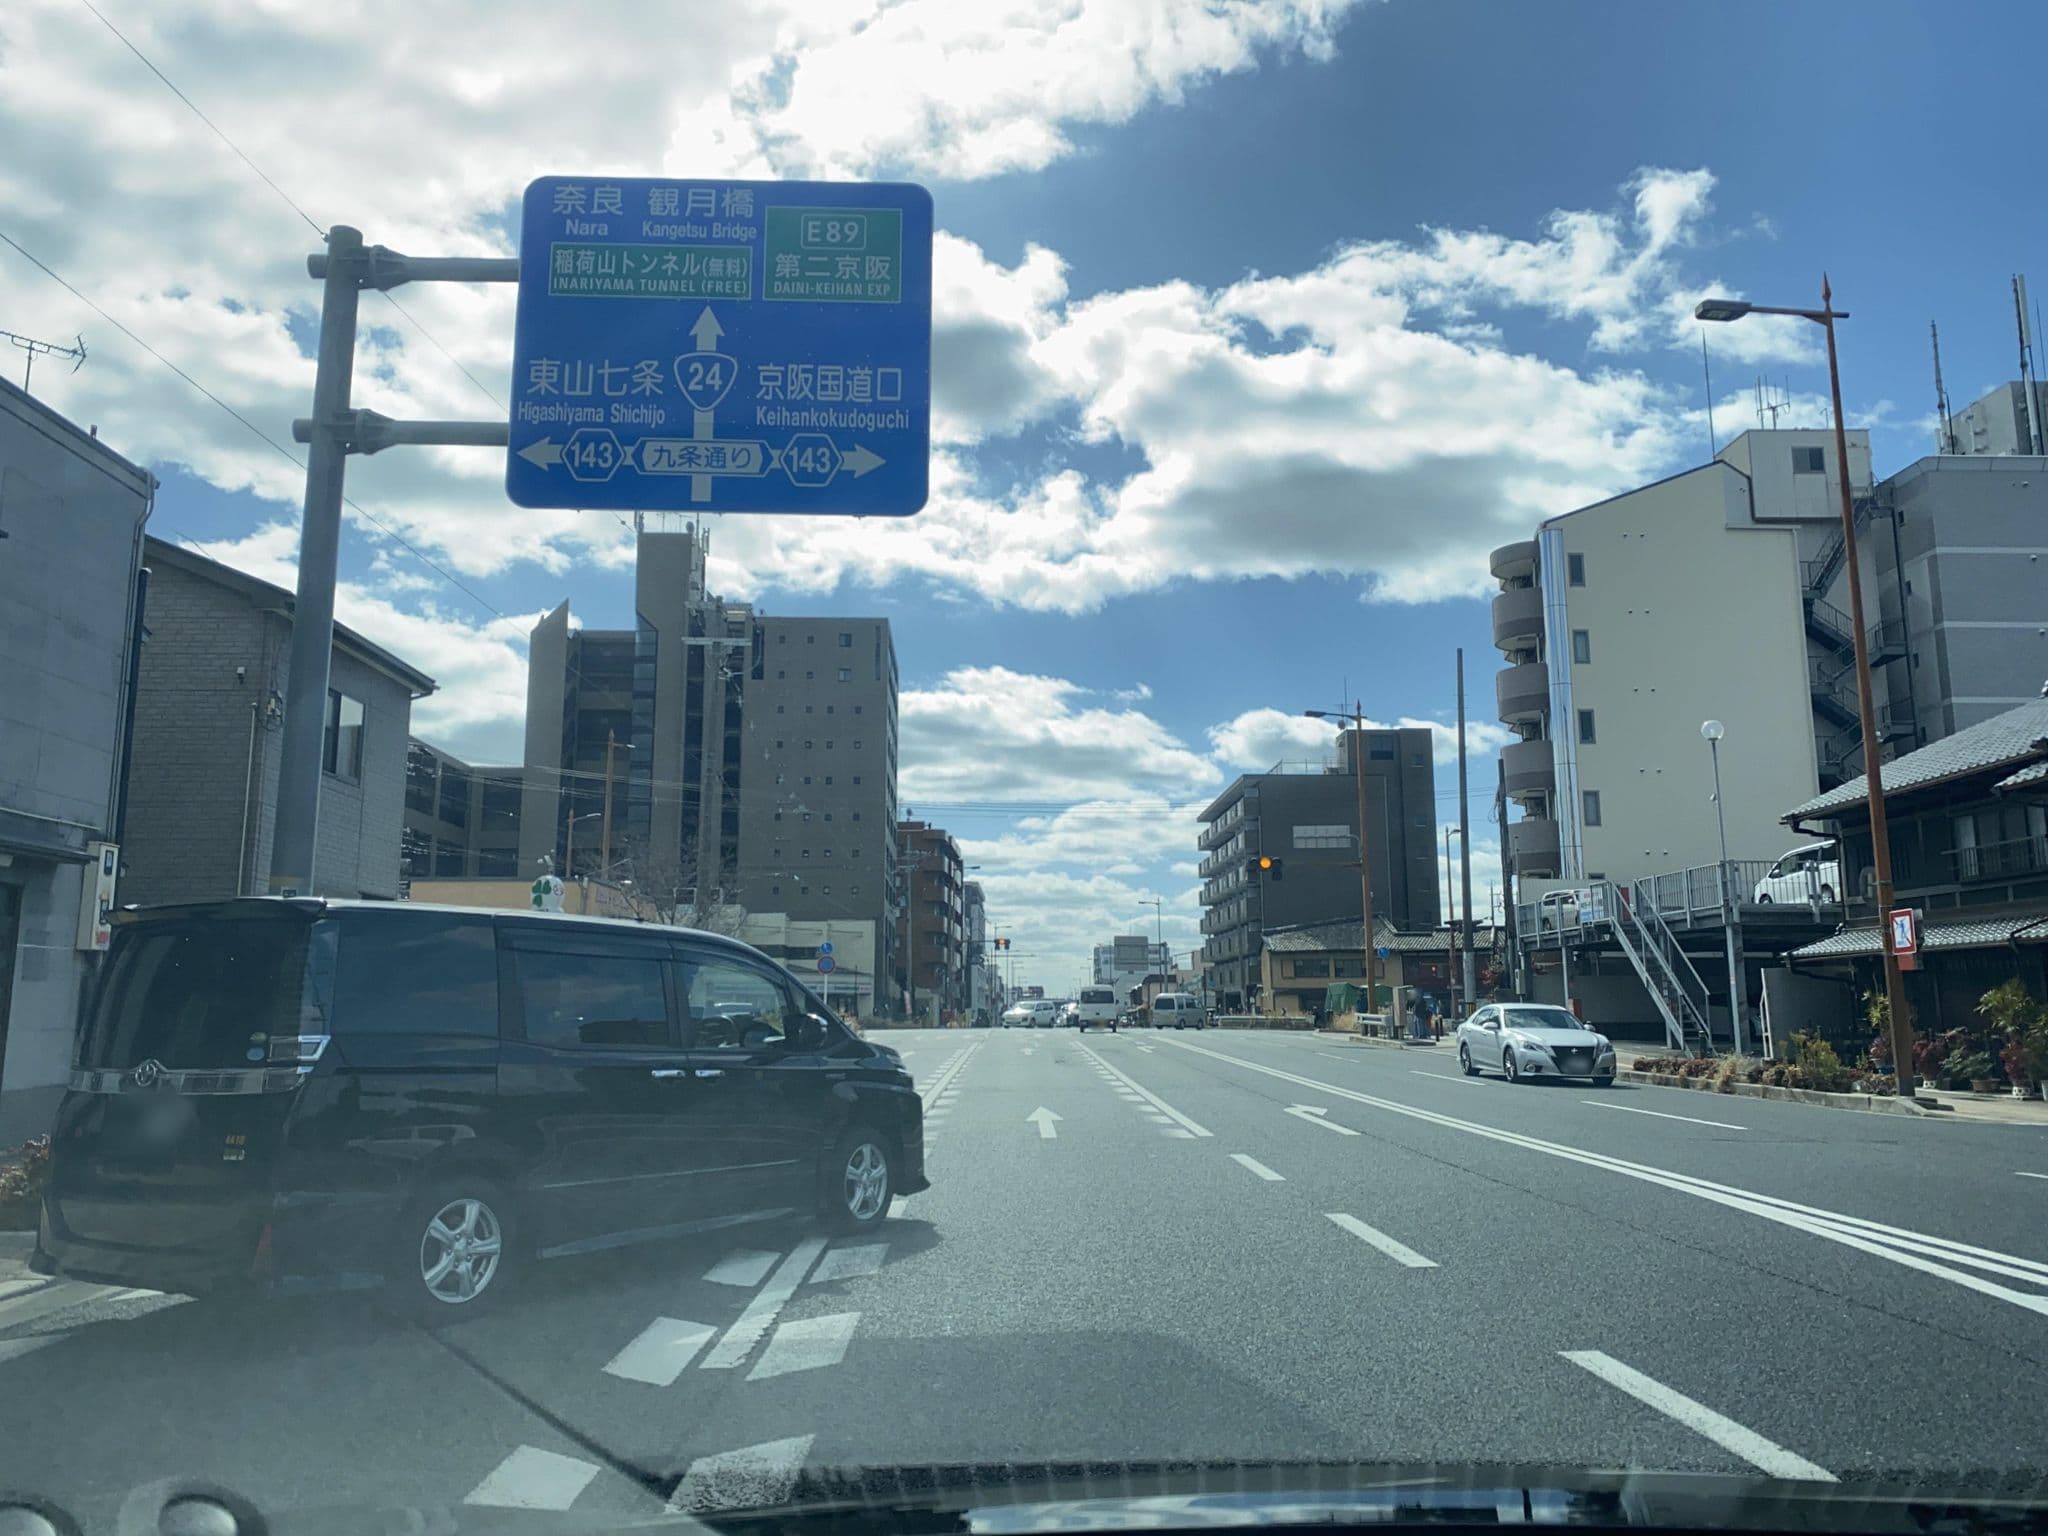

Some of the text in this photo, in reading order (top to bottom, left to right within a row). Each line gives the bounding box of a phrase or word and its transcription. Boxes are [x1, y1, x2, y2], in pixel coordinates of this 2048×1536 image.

[552, 183, 623, 214] 奈良
[648, 187, 755, 217] 観月橋
[566, 219, 608, 235] Nara
[642, 221, 757, 242] Kangetsu Bridge
[807, 221, 859, 243] E89
[774, 254, 892, 280] 第二京阪
[554, 277, 746, 294] INARIYAMA TUNNEL (FREE)
[774, 282, 891, 297] DAINI-KEIHAN EXP
[527, 358, 664, 396] 東山七条
[688, 362, 722, 391] 24
[756, 363, 902, 402] 京阪国道口
[518, 401, 665, 429] Higashiyama Shichijo
[757, 406, 909, 432] Keihankokudoguchi
[570, 442, 613, 467] 143
[651, 445, 752, 470] 九条通り
[788, 447, 831, 474] 143
